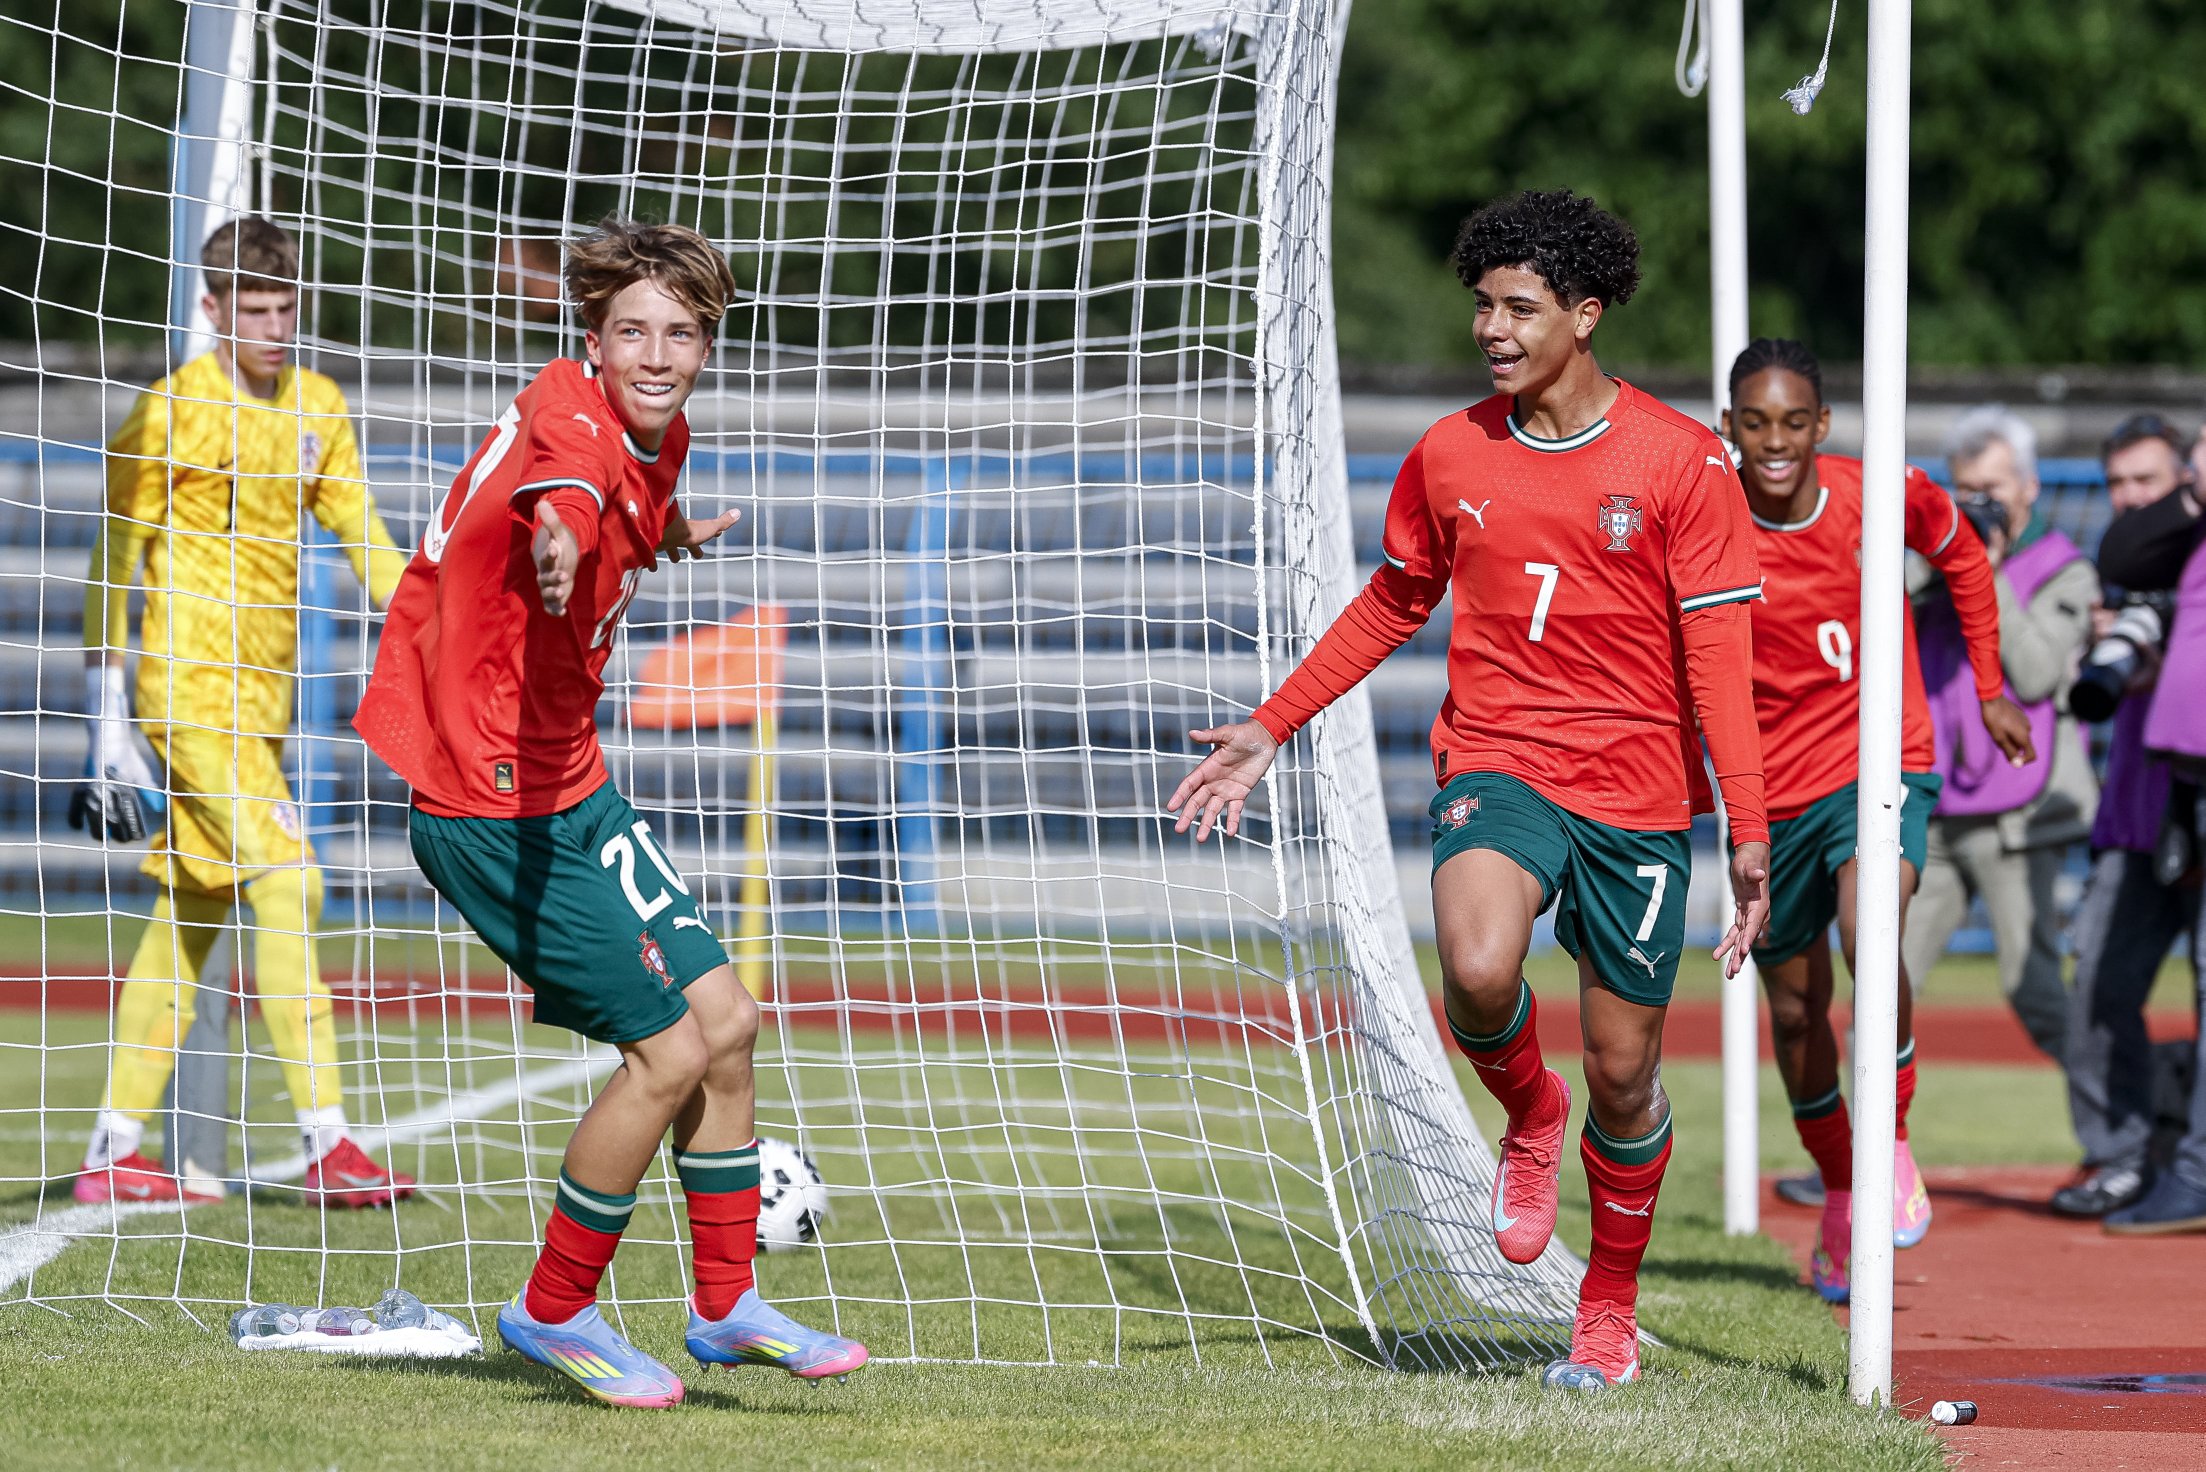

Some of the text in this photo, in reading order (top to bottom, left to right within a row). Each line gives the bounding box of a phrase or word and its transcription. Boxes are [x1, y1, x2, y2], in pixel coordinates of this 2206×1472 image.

[590, 565, 643, 649] 20
[1525, 561, 1560, 642] 7
[1817, 619, 1853, 683] 9
[600, 819, 690, 923] 20
[1635, 863, 1668, 941] 7
